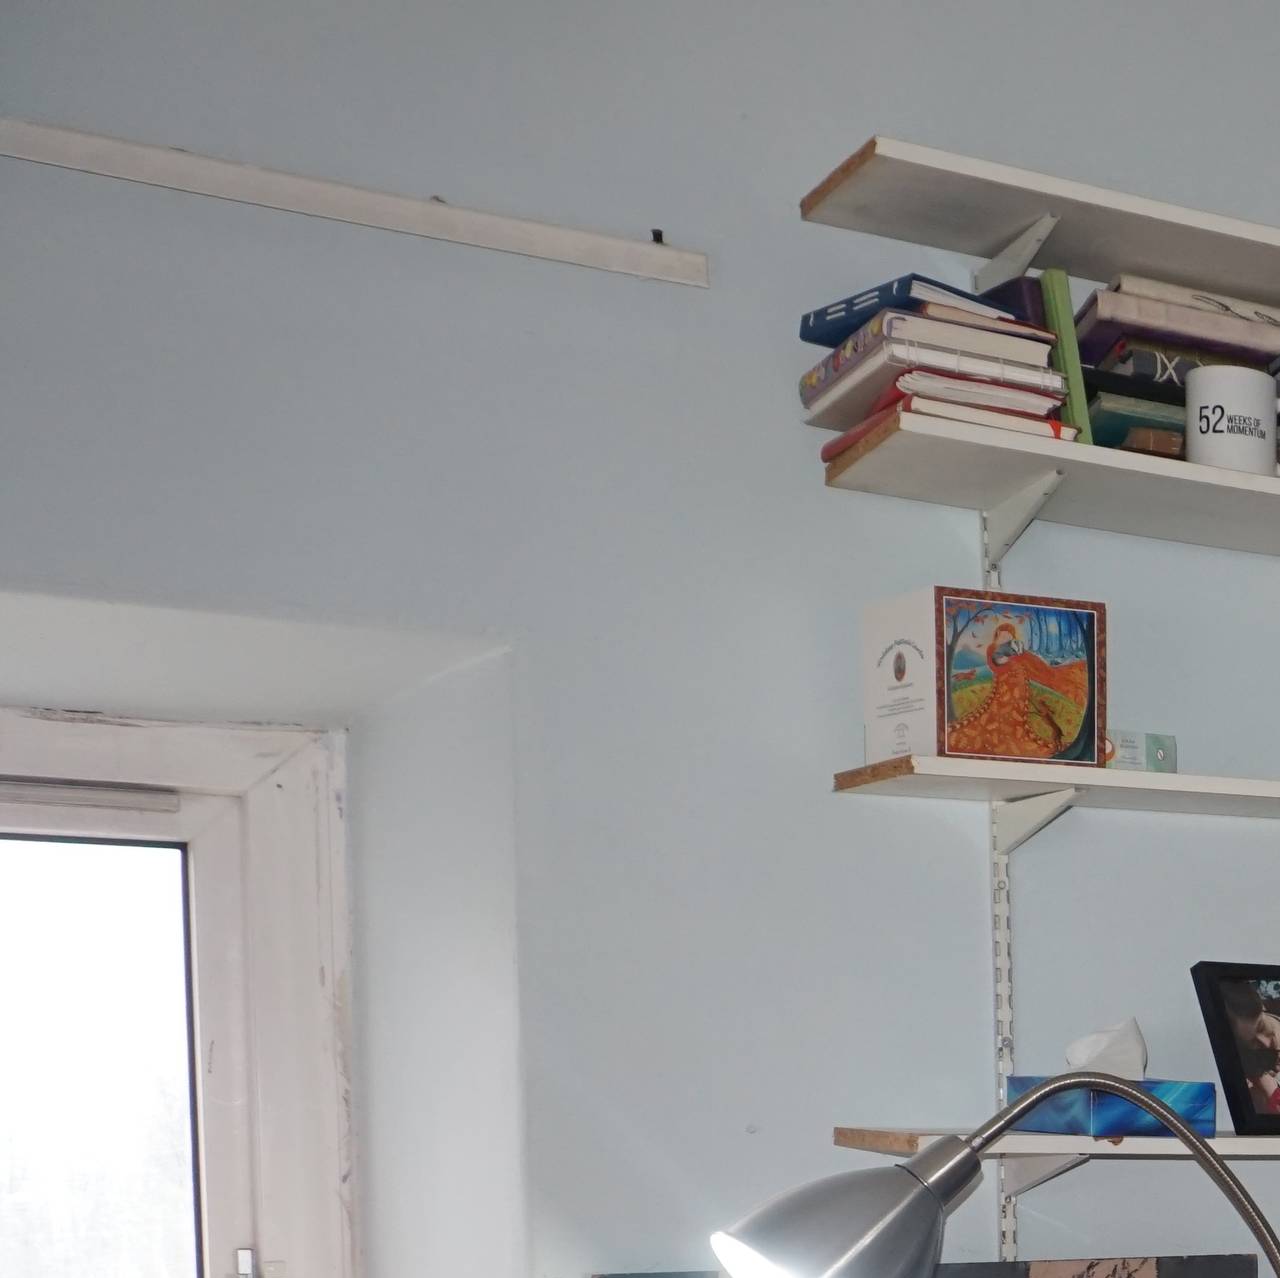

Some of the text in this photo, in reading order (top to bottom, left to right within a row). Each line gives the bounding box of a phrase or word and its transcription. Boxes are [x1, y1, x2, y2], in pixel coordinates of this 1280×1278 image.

[1199, 405, 1262, 434] 52 WEEKS OF
[1227, 424, 1266, 440] MOMENTUM
